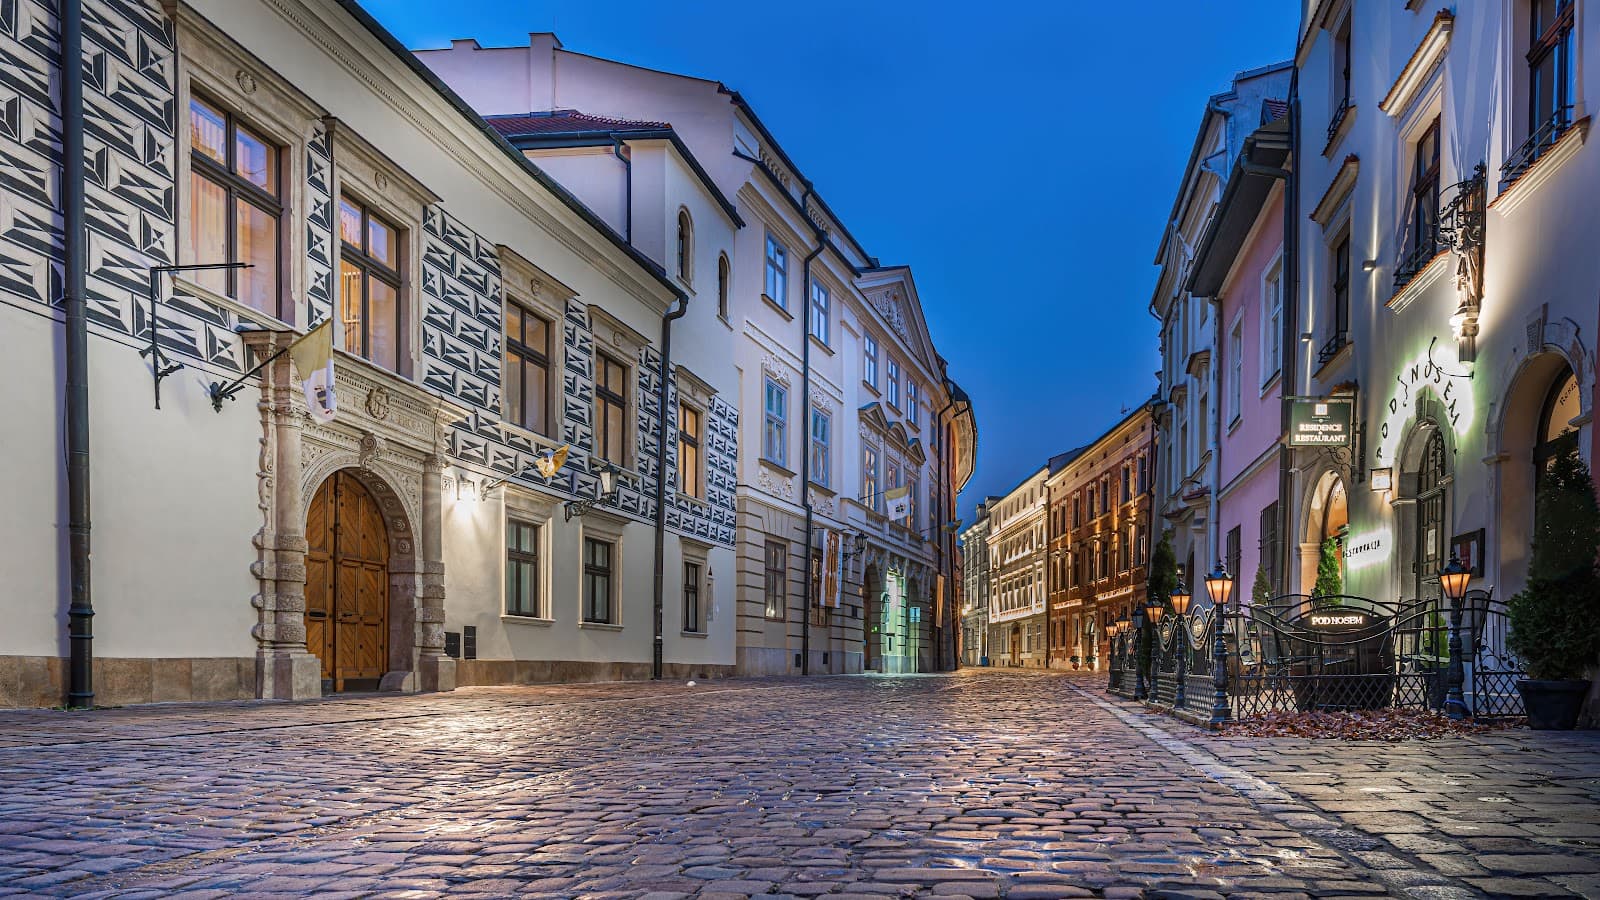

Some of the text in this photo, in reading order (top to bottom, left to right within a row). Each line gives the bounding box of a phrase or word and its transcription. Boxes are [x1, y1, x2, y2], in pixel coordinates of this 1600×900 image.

[1299, 423, 1342, 432] RESIDENCE
[1295, 434, 1346, 442] RESTAURANT
[1311, 616, 1363, 625] POD NOSEM
